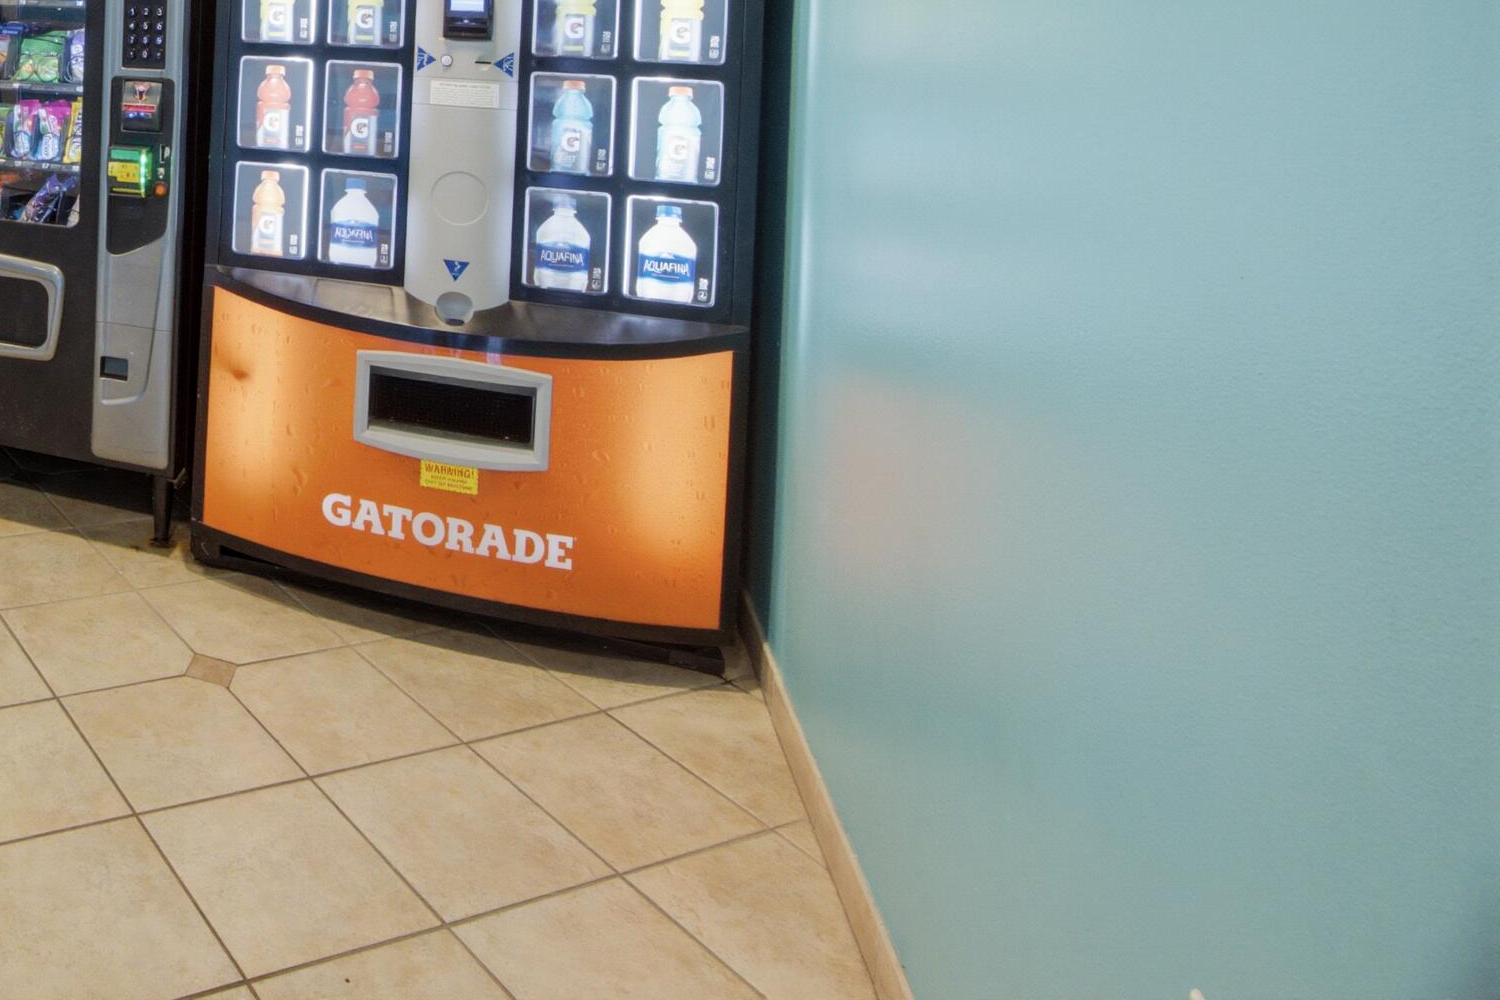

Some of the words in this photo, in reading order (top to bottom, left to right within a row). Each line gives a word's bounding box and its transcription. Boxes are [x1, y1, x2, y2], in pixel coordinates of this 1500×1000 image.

[540, 249, 584, 266] AQUAFINA
[643, 259, 690, 277] AQUAFINA
[425, 463, 475, 479] WARNING!
[322, 493, 574, 570] GATORADE
